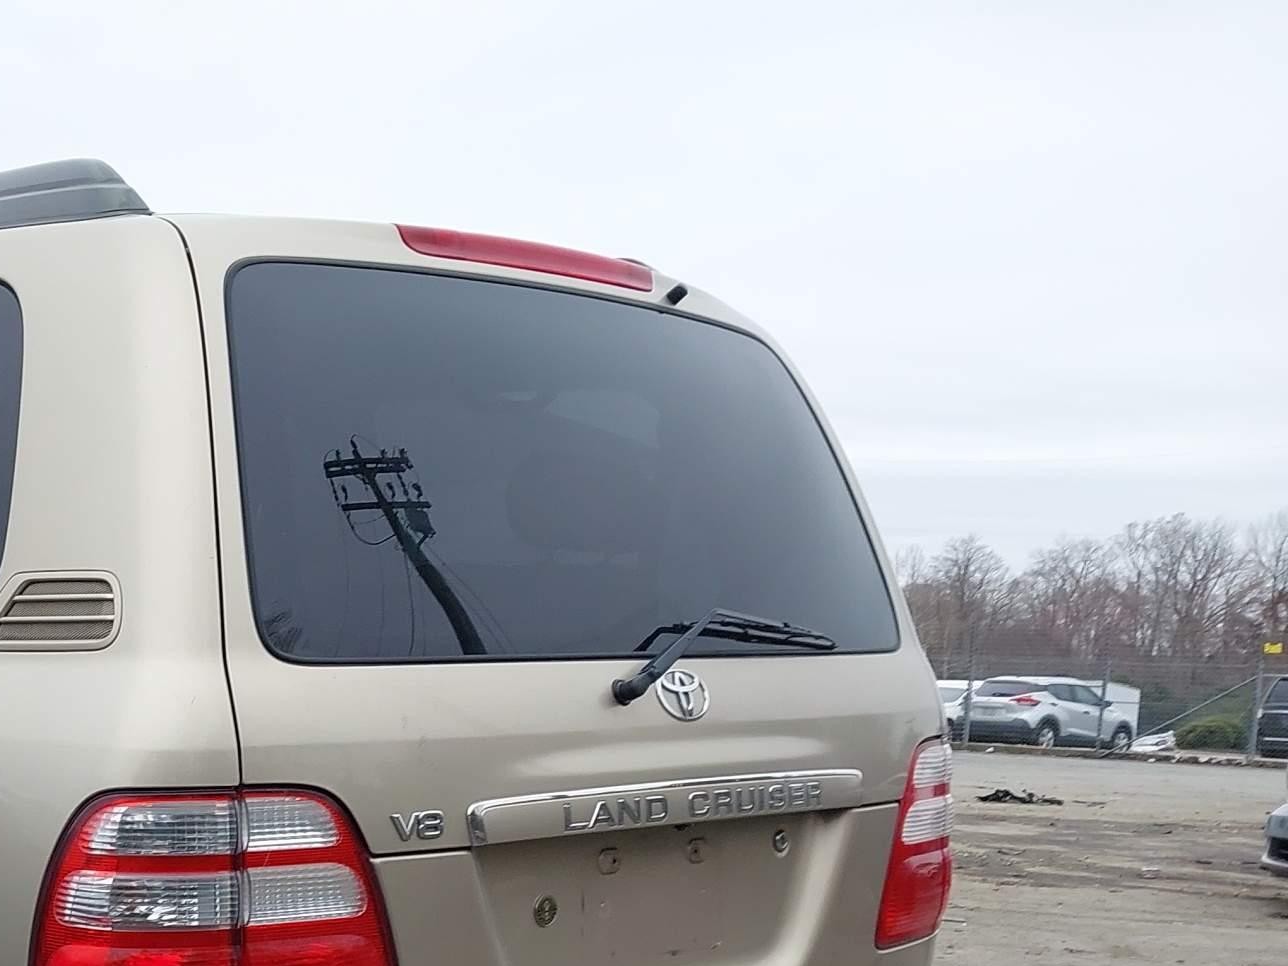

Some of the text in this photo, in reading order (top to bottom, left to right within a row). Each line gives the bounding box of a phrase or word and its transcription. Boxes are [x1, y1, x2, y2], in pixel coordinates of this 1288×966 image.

[390, 809, 443, 841] V8
[563, 781, 822, 832] LAND CRUISER
